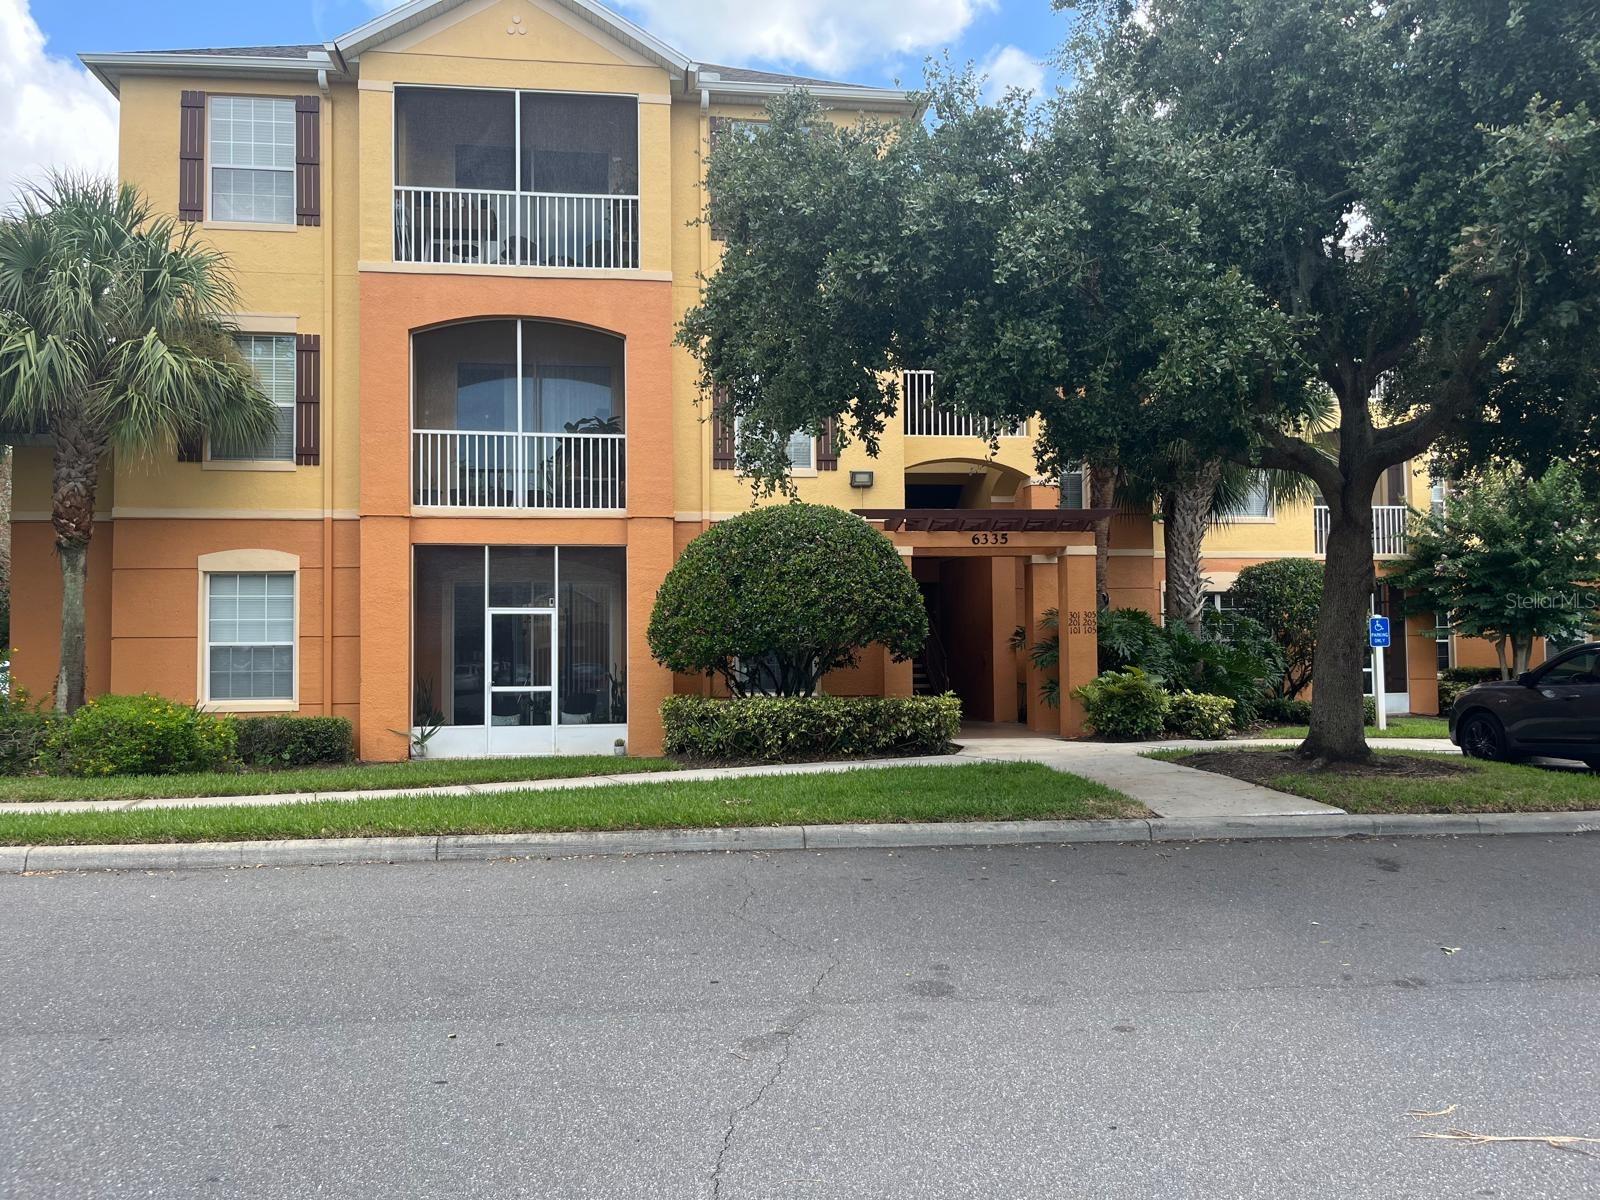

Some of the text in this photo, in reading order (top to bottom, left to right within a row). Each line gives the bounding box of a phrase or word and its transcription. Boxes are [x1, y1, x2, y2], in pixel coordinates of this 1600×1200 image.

[971, 533, 1009, 545] 6335
[1069, 611, 1097, 619] 301 305
